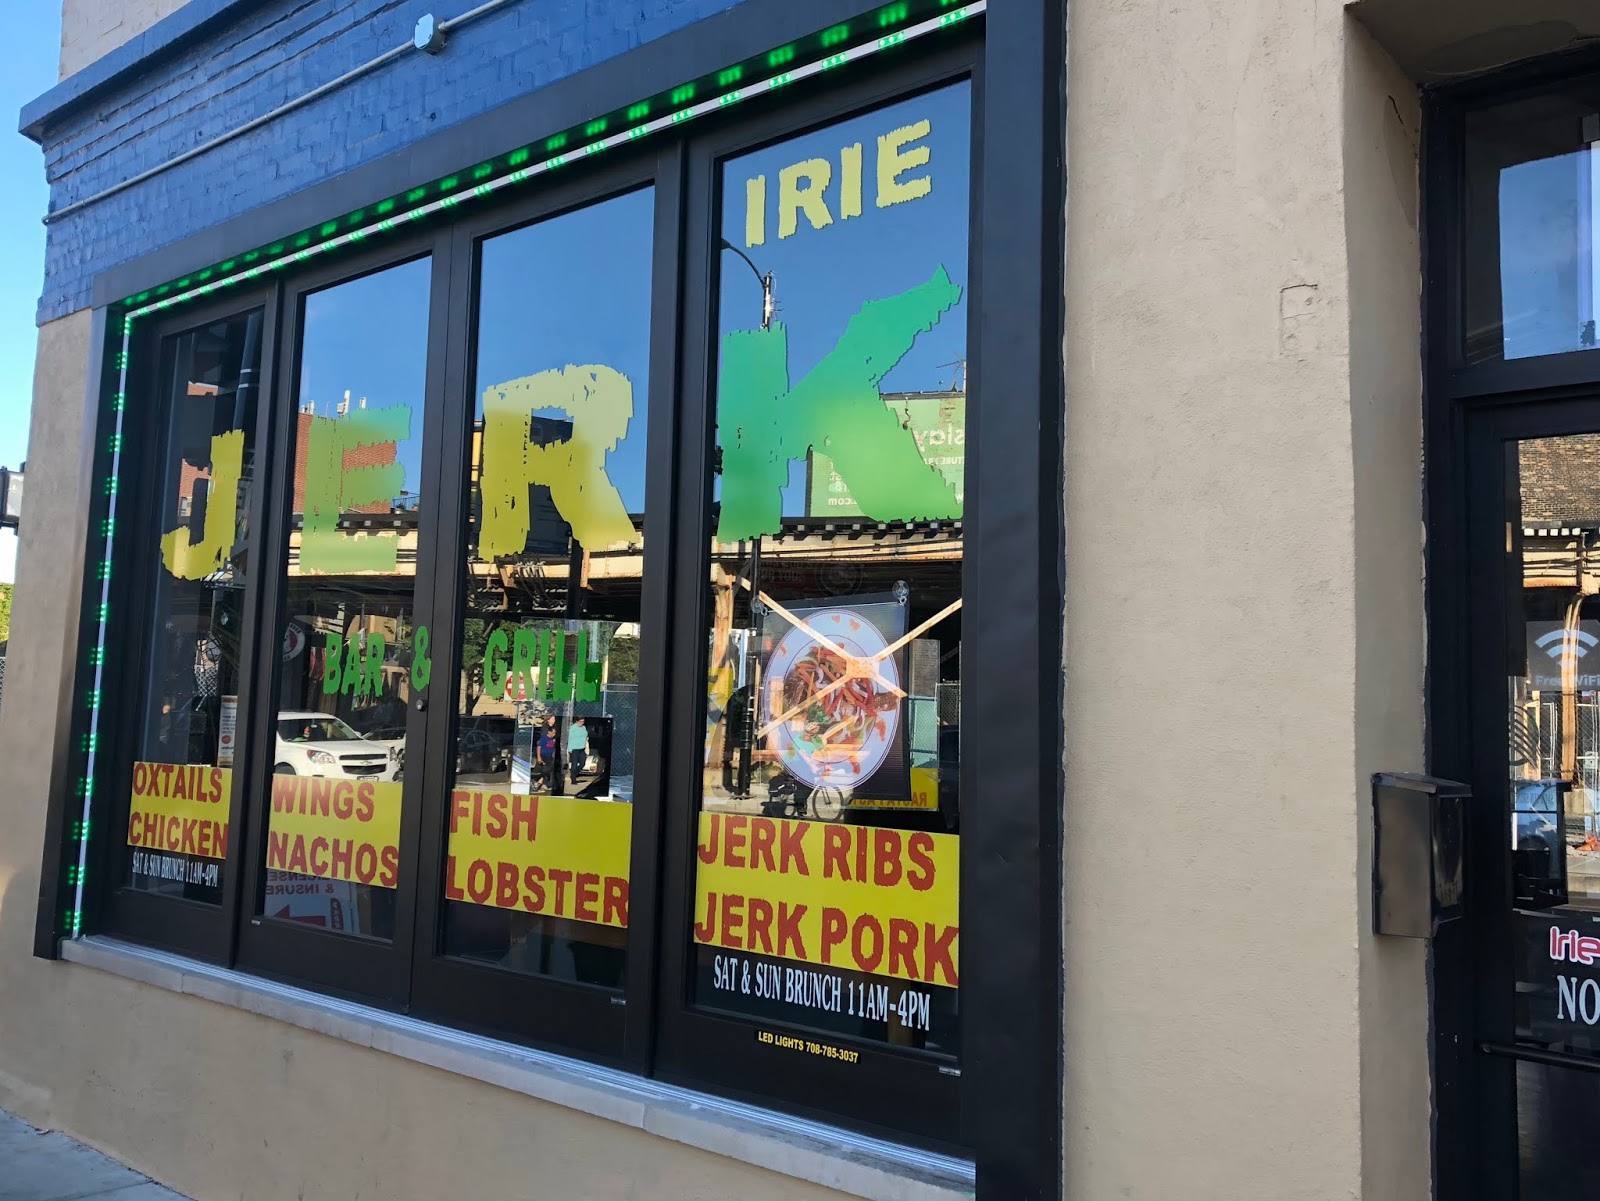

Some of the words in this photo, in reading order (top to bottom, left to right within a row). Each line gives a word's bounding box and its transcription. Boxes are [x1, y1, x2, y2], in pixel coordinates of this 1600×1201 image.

[745, 119, 932, 248] IRIE
[160, 264, 963, 579] JERK
[323, 632, 386, 696] BAR
[411, 626, 432, 692] &
[484, 628, 603, 702] GRILL
[132, 762, 223, 804] OXTAILS
[272, 781, 375, 823] WINGS
[128, 811, 228, 859] CHICKEN
[451, 791, 539, 842] FISH
[132, 851, 144, 874] SAT
[143, 853, 149, 875] &
[149, 854, 161, 877] SUN
[161, 856, 185, 882] BRUNCH
[269, 831, 399, 887] NACHOS
[698, 814, 810, 876] JERK
[823, 824, 936, 892] RIBS
[446, 855, 629, 927] LOBSTER
[694, 892, 808, 960] JERK
[821, 906, 960, 987] PORK
[1550, 926, 1600, 965] Irie
[714, 955, 738, 991] SAT
[741, 959, 751, 994] &
[755, 962, 782, 1000] SUN
[785, 968, 842, 1013] BRUNCH
[848, 980, 931, 1031] 11AM-4PM
[758, 1031, 774, 1044] LED
[775, 1035, 804, 1051] LIGHTS
[806, 1042, 859, 1063] 708-785-3037
